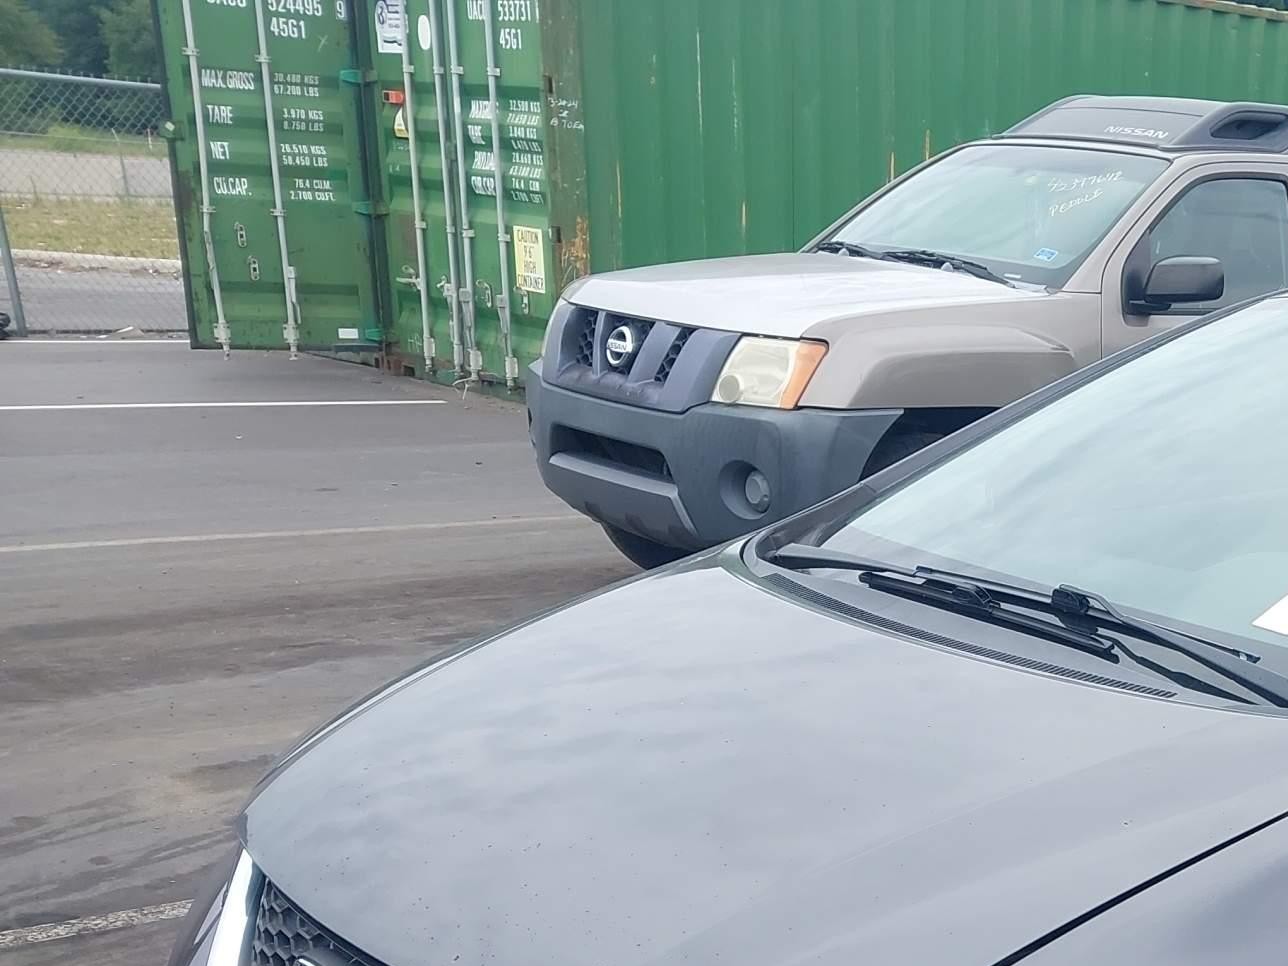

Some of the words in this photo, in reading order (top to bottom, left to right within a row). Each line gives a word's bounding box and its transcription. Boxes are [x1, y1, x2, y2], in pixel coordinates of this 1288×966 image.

[268, 0, 322, 16] 524495
[336, 0, 346, 18] 9
[498, 0, 531, 21] 533731
[270, 17, 306, 39] 45G1
[499, 28, 522, 49] 45G1
[304, 75, 319, 85] KGS
[304, 86, 319, 97] LBS
[206, 105, 233, 124] TARE
[308, 110, 324, 121] KGS
[1103, 126, 1169, 139] NISSAN
[210, 141, 230, 160] NET
[310, 145, 327, 155] KGS
[313, 157, 328, 168] LBS
